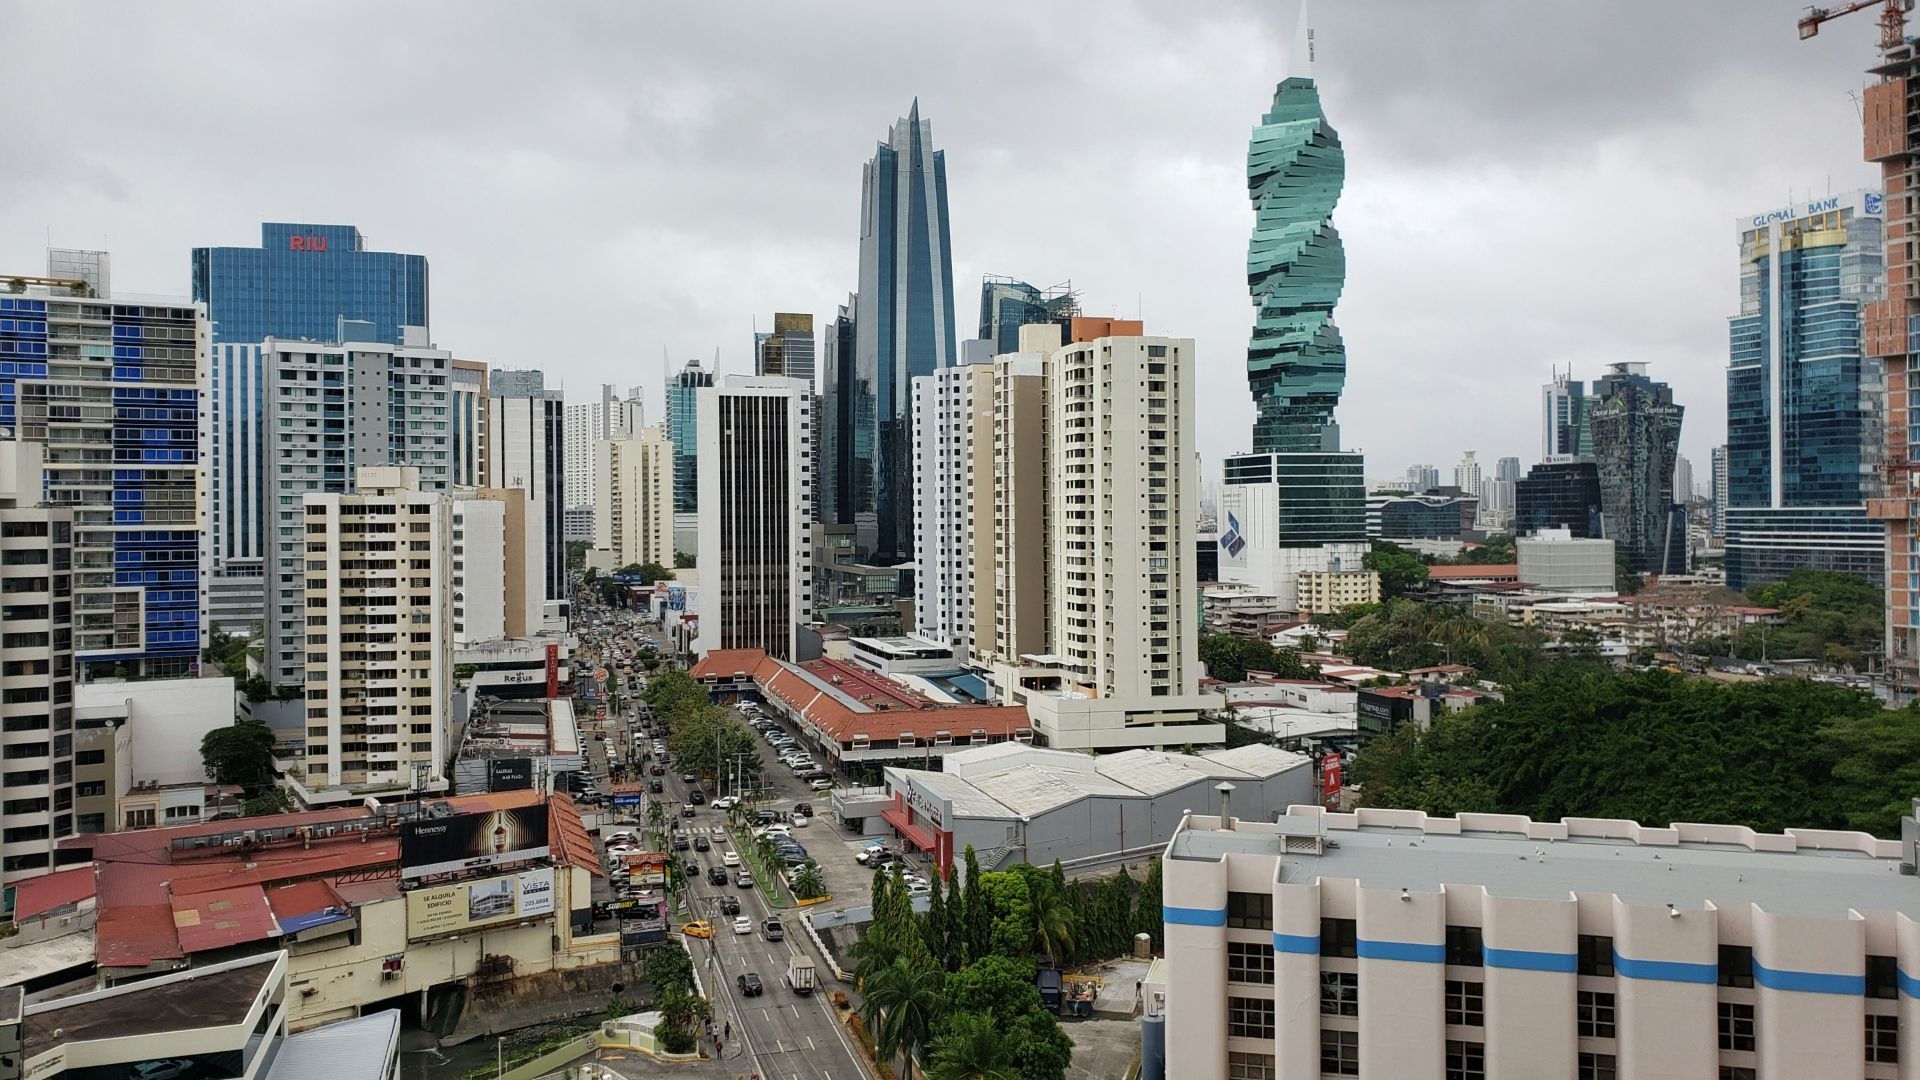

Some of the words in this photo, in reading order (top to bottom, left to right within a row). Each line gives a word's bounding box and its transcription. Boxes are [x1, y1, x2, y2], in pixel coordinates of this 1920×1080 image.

[1753, 208, 1797, 226] GLOBAL
[1808, 198, 1838, 214] BANK
[290, 235, 327, 251] RIU
[504, 675, 533, 683] Regus
[415, 825, 448, 835] Hennessy
[522, 880, 550, 890] VISTA
[431, 891, 456, 900] ALQUILA
[427, 900, 452, 909] EDIFICIO
[606, 900, 637, 911] SUBWAY
